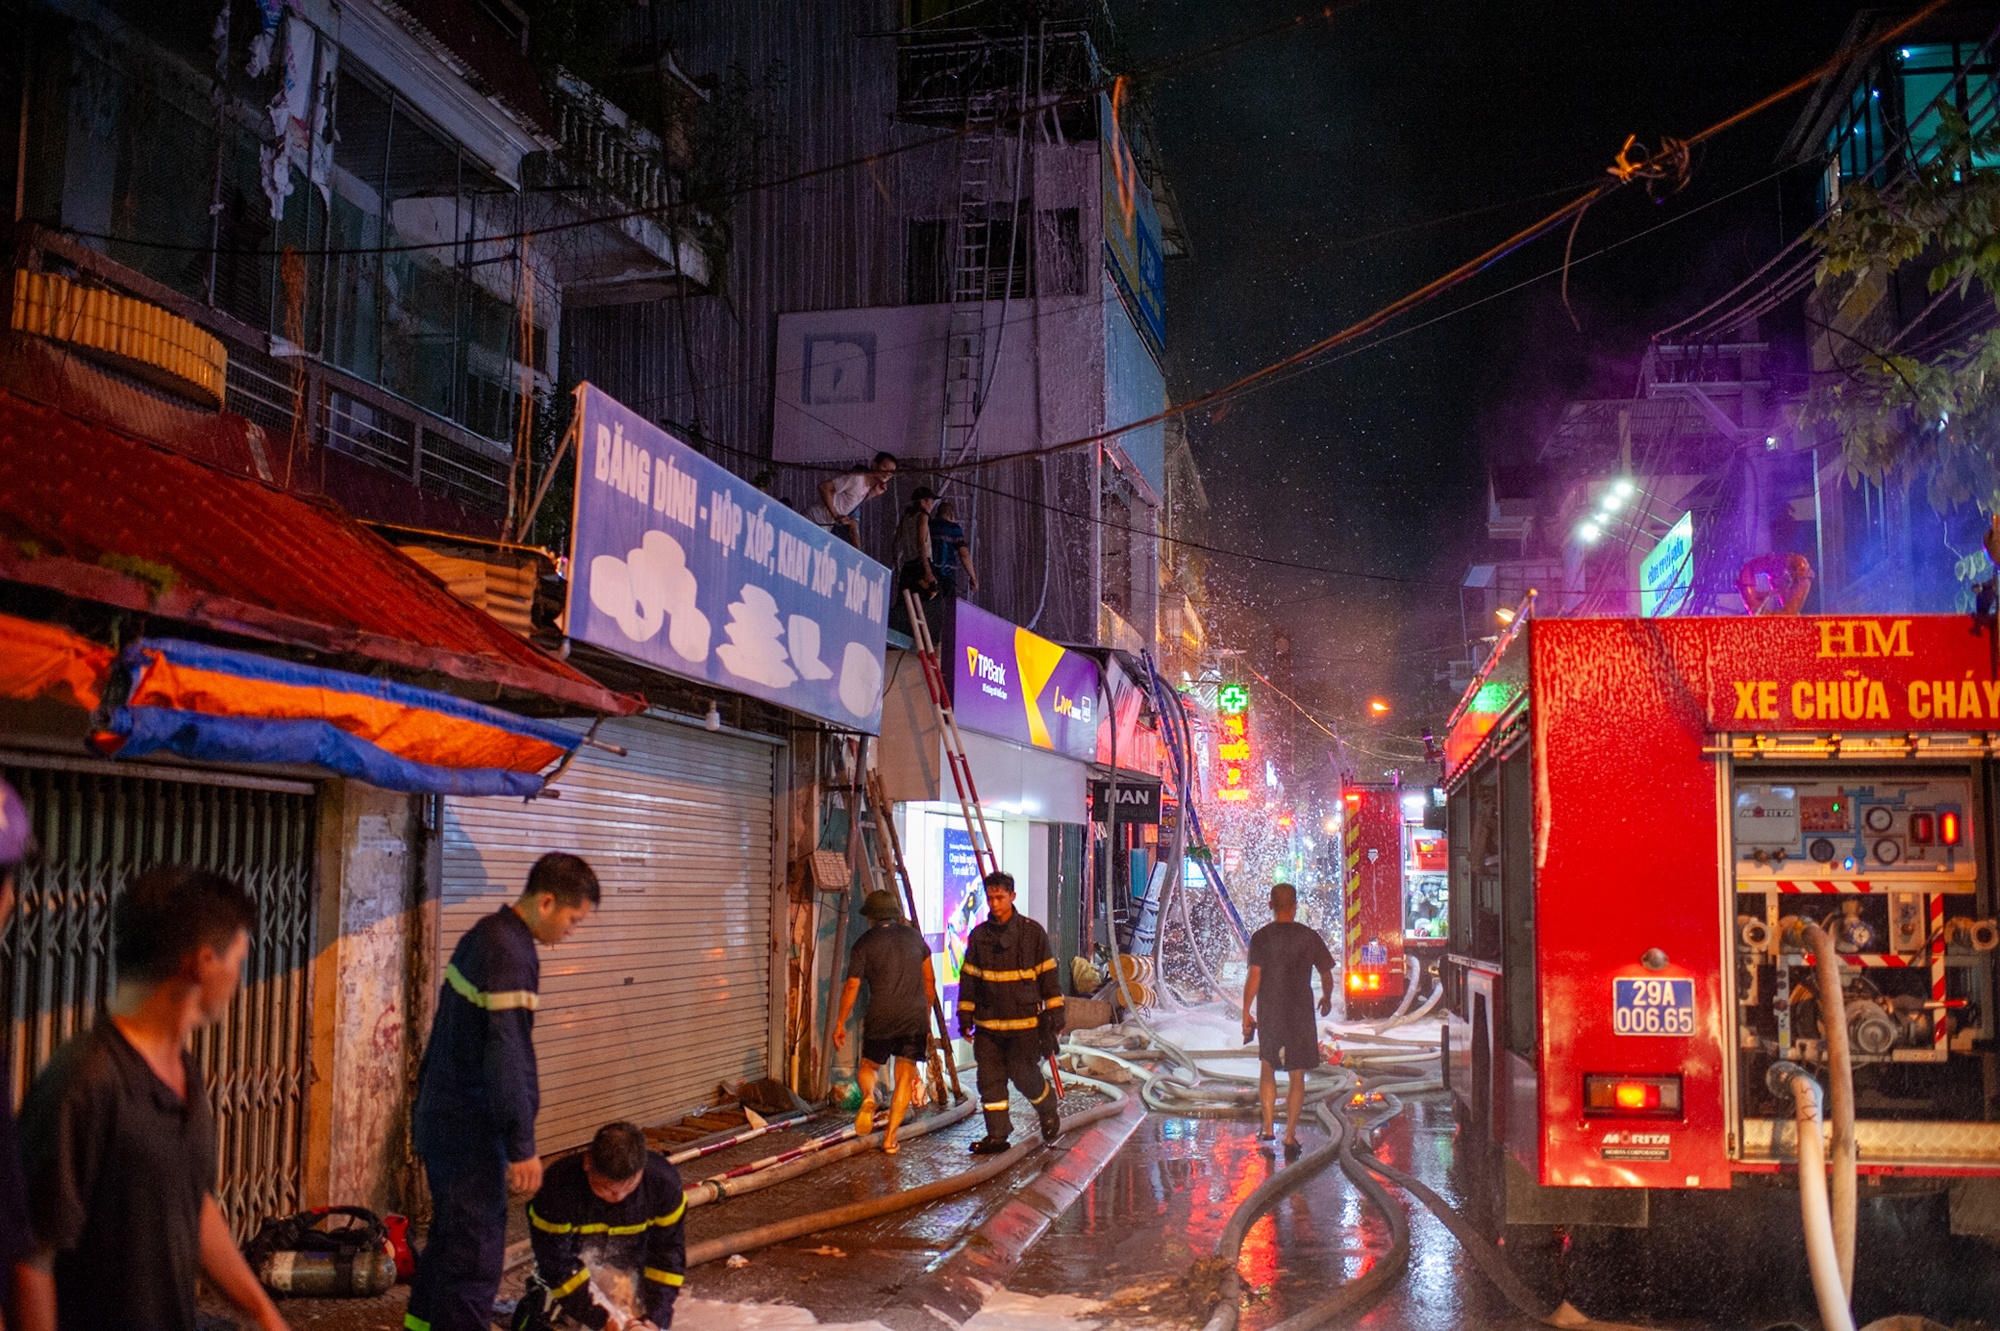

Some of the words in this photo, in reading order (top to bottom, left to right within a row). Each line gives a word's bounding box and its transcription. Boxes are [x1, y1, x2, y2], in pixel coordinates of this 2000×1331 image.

[595, 420, 651, 505] BĂNG
[653, 454, 697, 529] DÍNH
[710, 488, 743, 557] HỘP
[743, 504, 775, 576] XỐP,
[777, 529, 812, 588] KHAY
[811, 541, 838, 599] XỐP
[844, 560, 868, 615] XỐP
[1815, 620, 1914, 658] HM
[978, 653, 1006, 686] TPBank
[1733, 680, 1779, 720] XE
[1791, 669, 1890, 720] CHỮA
[1907, 670, 2000, 720] CHÁY
[1104, 788, 1149, 805] MAN
[1739, 806, 1795, 818] MORITA
[1633, 981, 1676, 1006] 29A
[1617, 1007, 1692, 1033] 006.65
[1602, 1130, 1670, 1145] MORITA
